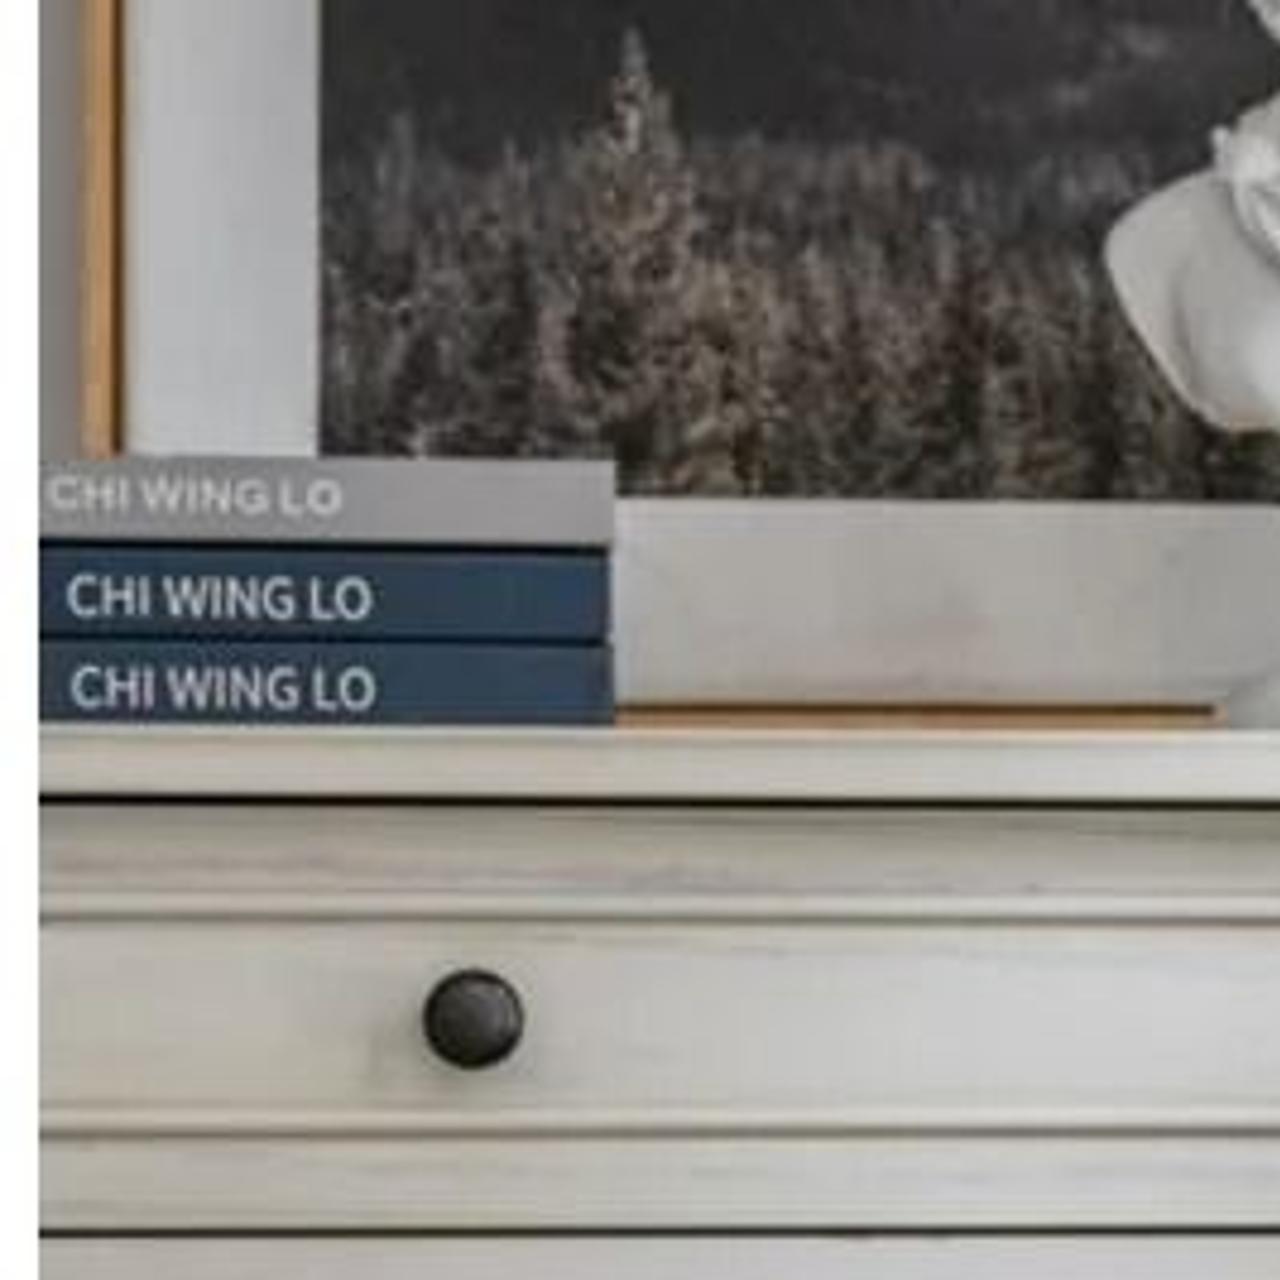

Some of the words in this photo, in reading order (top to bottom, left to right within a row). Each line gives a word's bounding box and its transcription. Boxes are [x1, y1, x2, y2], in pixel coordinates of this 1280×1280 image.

[48, 474, 130, 512] CHI
[140, 474, 270, 516] WING
[278, 478, 343, 517] LO
[66, 573, 152, 619] CHI
[162, 575, 297, 621] WING
[309, 575, 373, 621] LO
[70, 664, 155, 710] CHI
[166, 666, 300, 711] WING
[312, 666, 376, 711] LO
